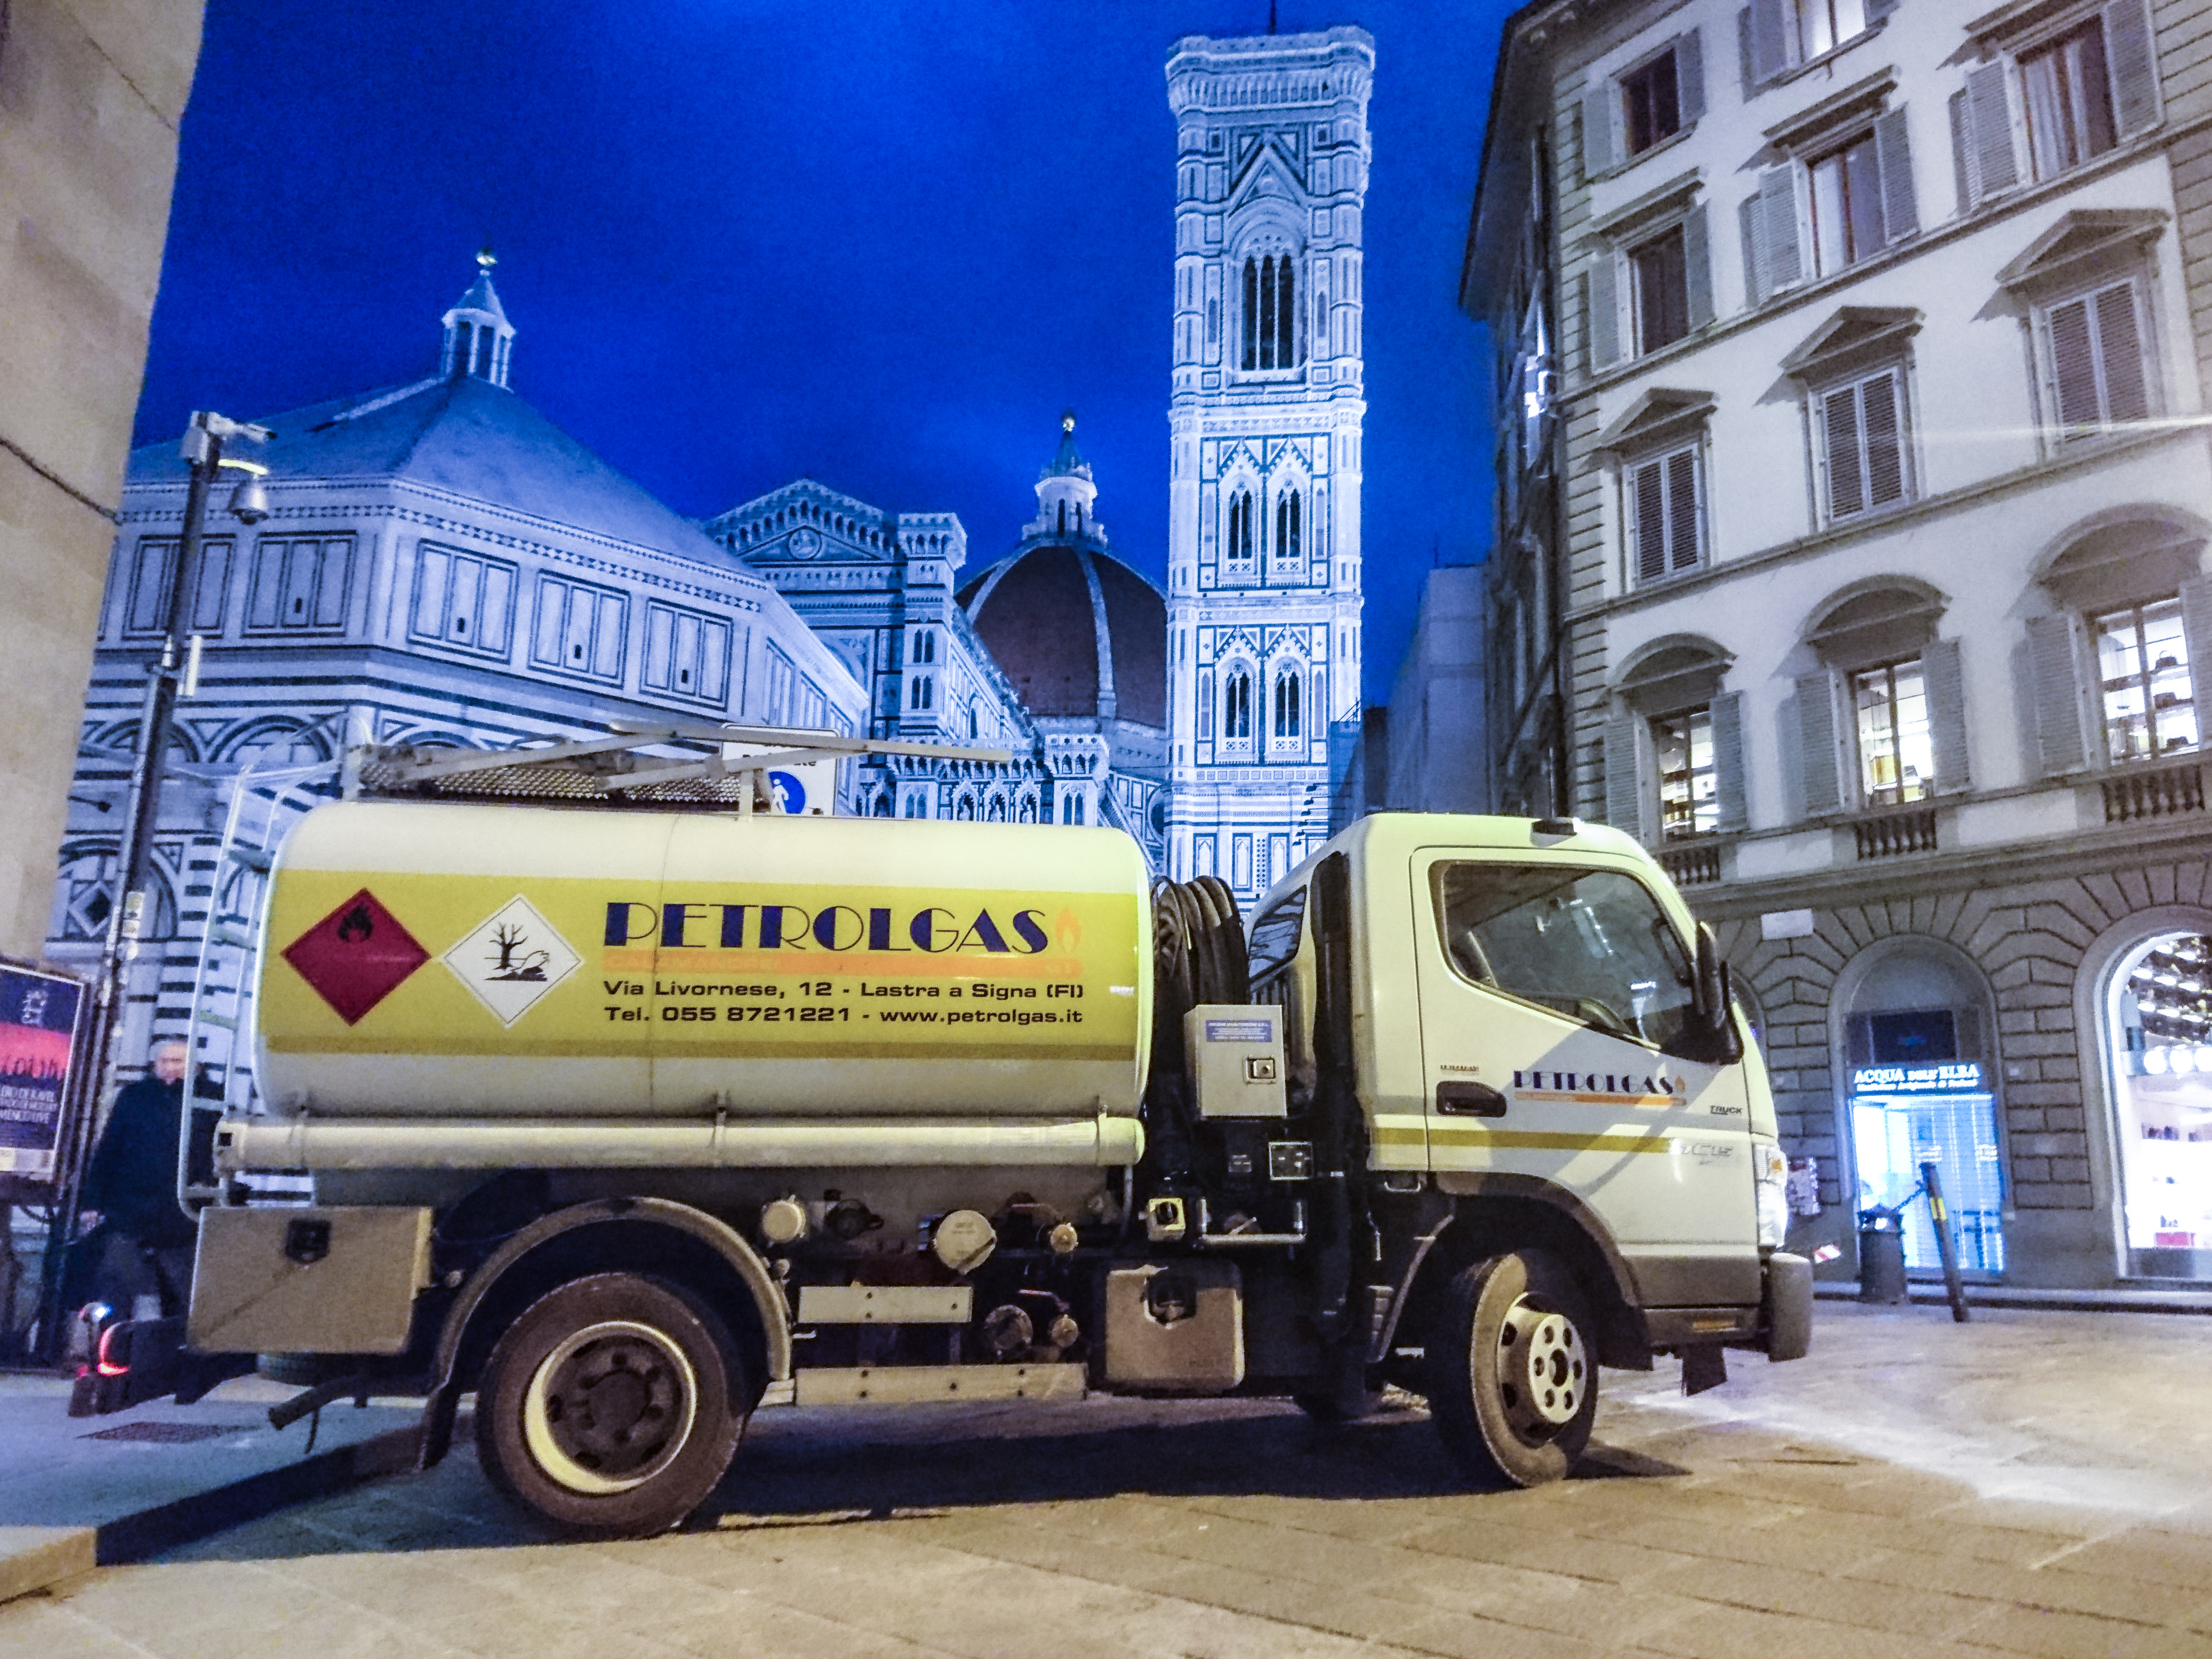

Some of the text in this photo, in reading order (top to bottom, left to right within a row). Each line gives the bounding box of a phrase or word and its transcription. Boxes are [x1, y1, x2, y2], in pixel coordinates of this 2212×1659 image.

[603, 902, 1049, 954] PETROLGAS
[603, 980, 644, 996] Via
[654, 981, 785, 999] Livornese,
[799, 982, 832, 996] 12
[861, 983, 940, 998] Lastra
[949, 987, 962, 998] a
[971, 983, 1037, 1001] Signa
[1047, 984, 1083, 999] (FI)
[604, 1007, 651, 1022] Tel.
[662, 1007, 717, 1022] 055
[727, 1007, 849, 1022] 8721221
[880, 1009, 1083, 1026] www.petrolgas.it
[1854, 1068, 1905, 1083] ACQUA
